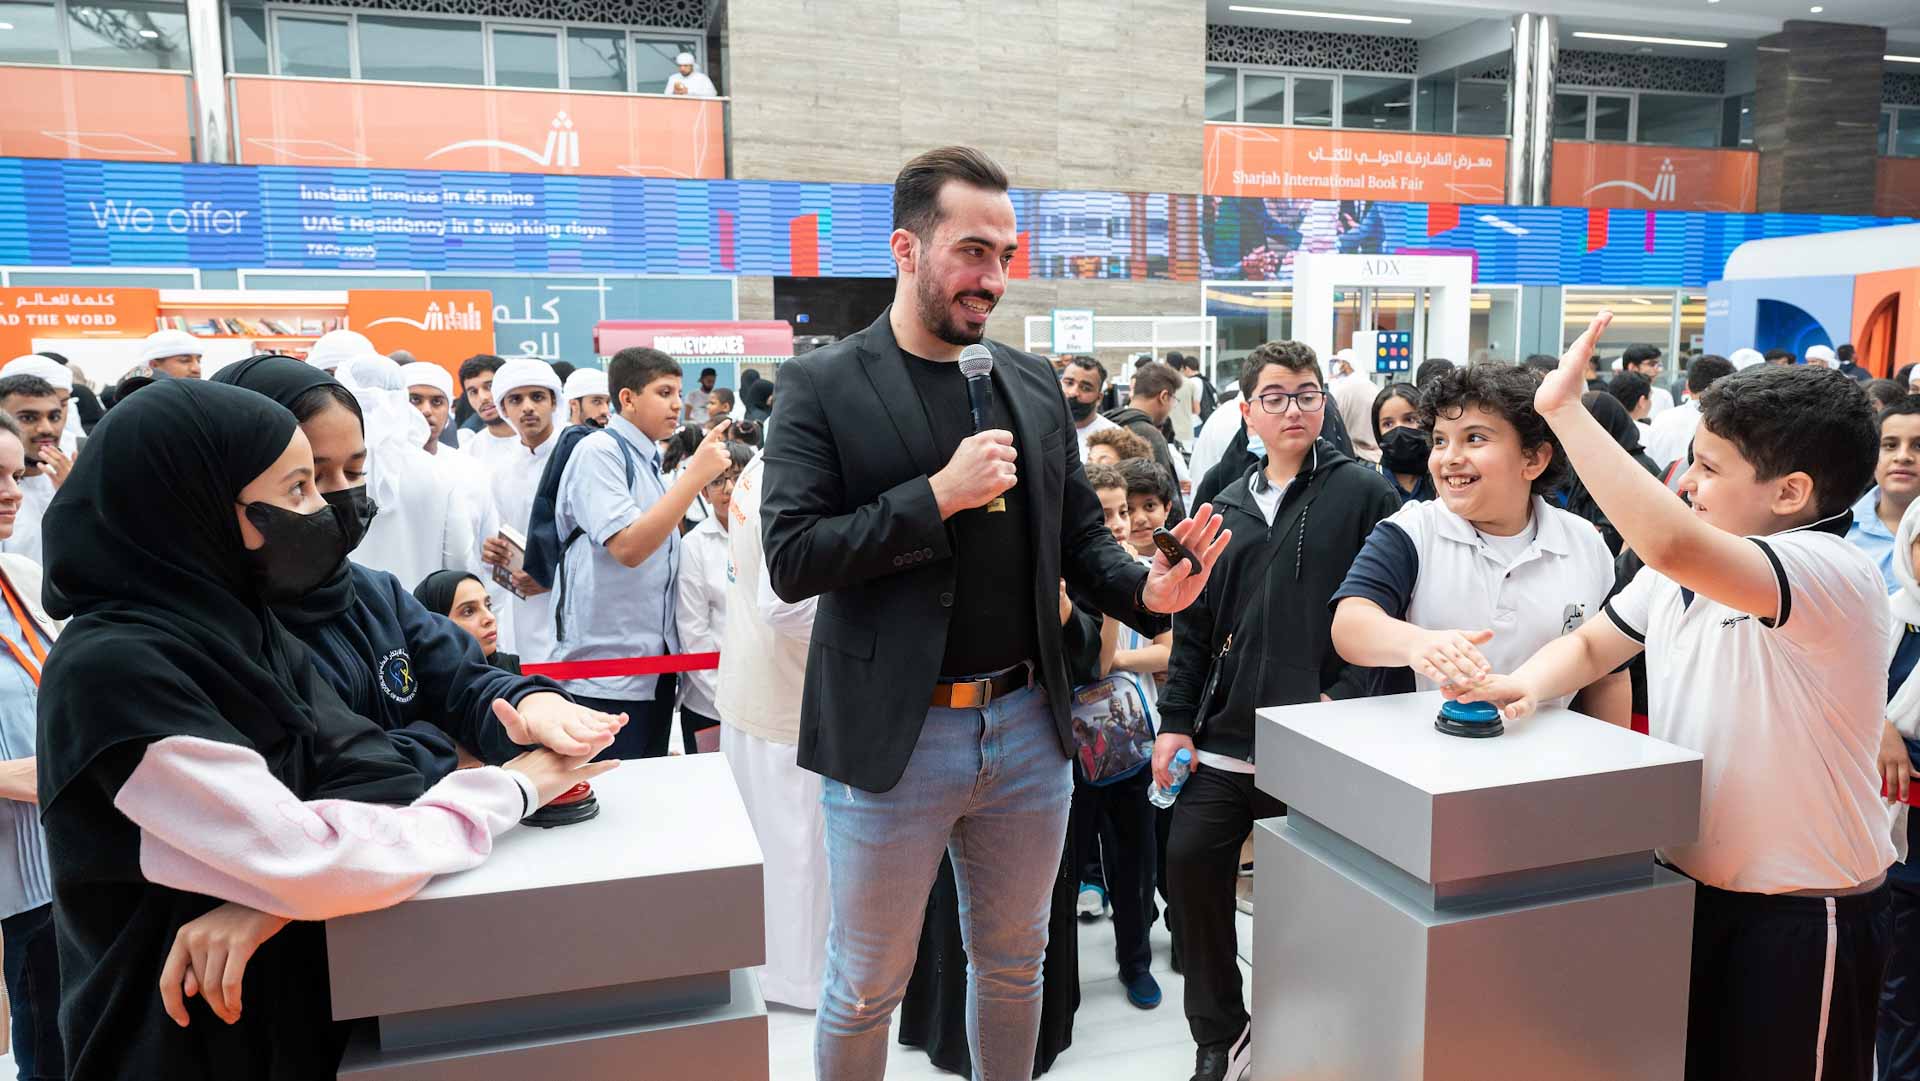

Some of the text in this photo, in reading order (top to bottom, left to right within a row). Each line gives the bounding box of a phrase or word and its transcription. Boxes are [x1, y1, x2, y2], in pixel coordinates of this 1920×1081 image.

[1232, 171, 1424, 191] Sharjah International Book Fair
[300, 184, 368, 202] Instant
[443, 188, 460, 204] in
[464, 190, 487, 204] 45
[491, 190, 534, 206] mins
[89, 199, 249, 234] We offer
[302, 216, 608, 239] UAE Residency in 5 working days
[1362, 259, 1400, 276] ADX
[25, 313, 60, 326] THE
[64, 313, 117, 326] WORD
